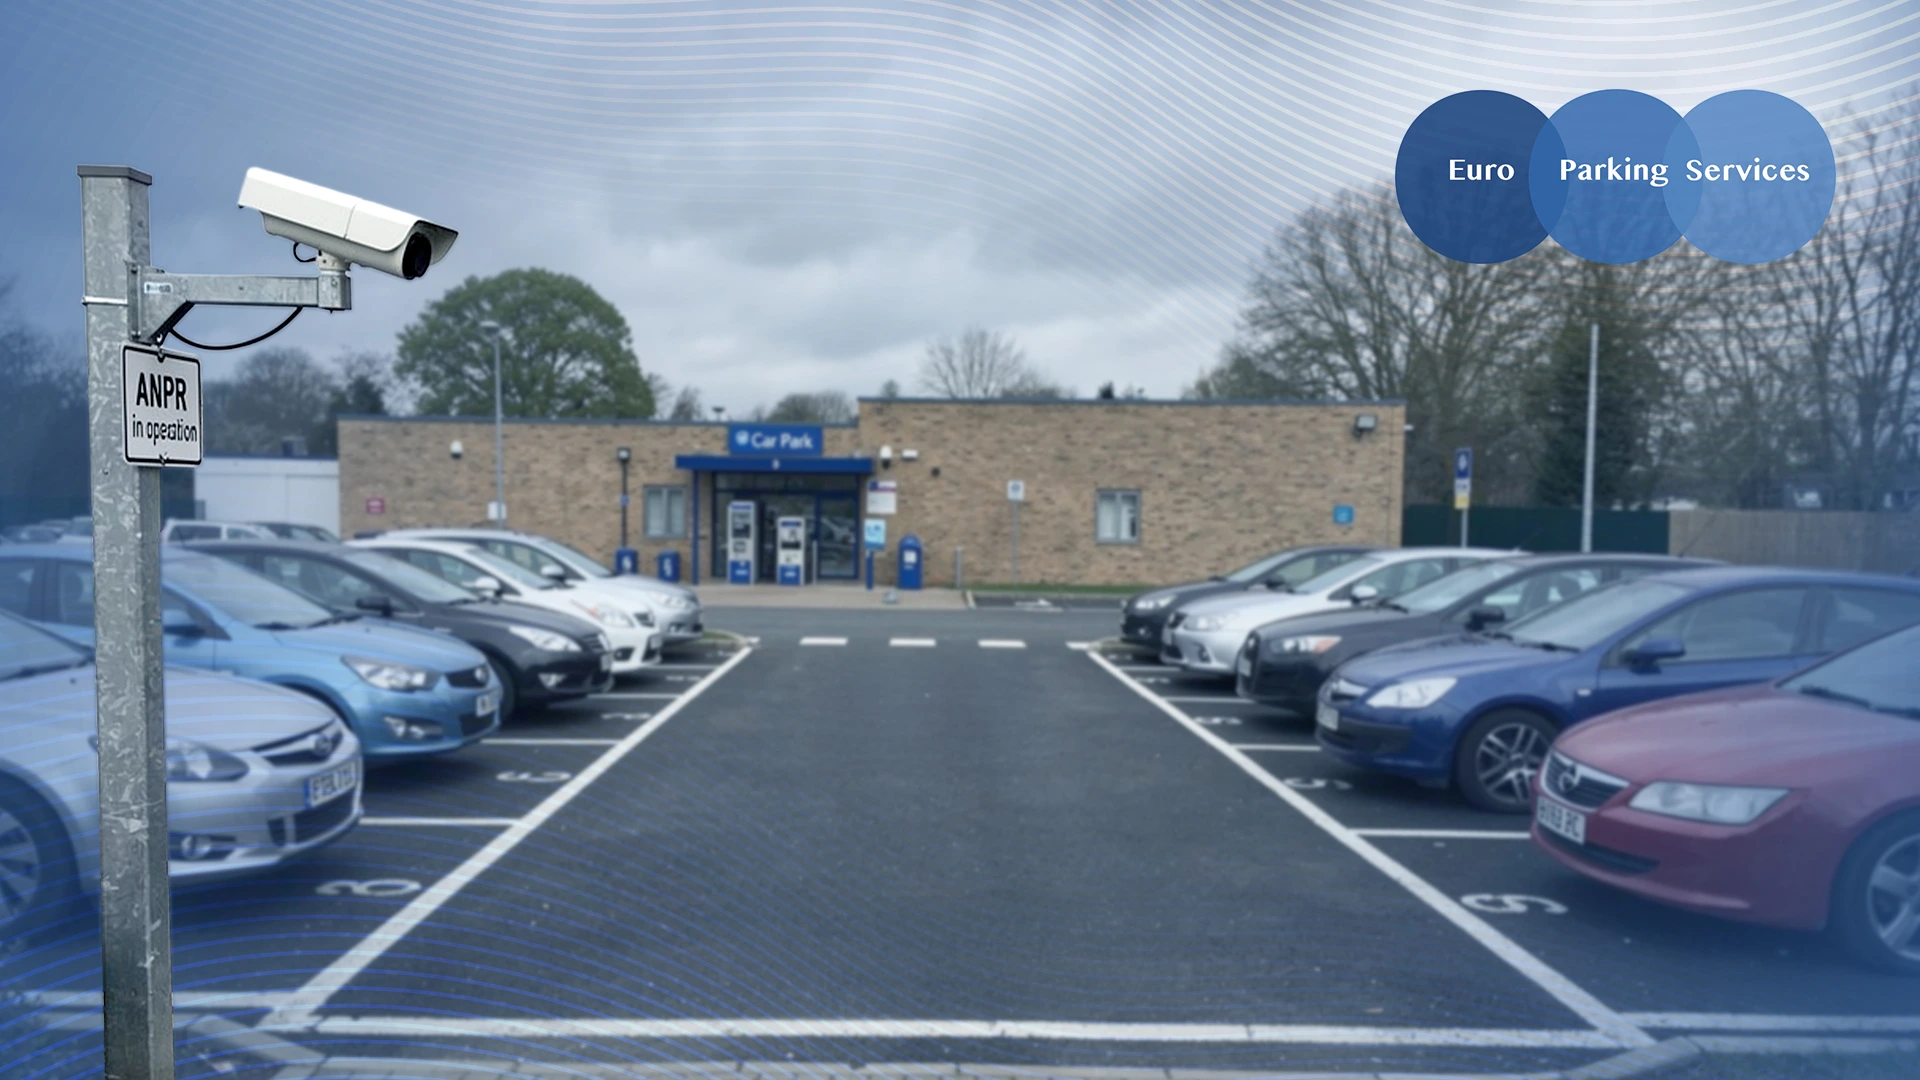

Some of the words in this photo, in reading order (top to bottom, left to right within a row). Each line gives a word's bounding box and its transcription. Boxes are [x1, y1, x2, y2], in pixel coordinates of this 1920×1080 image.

[136, 372, 187, 411] ANPR
[132, 413, 144, 438] in
[751, 432, 777, 449] Car
[780, 432, 813, 449] Park
